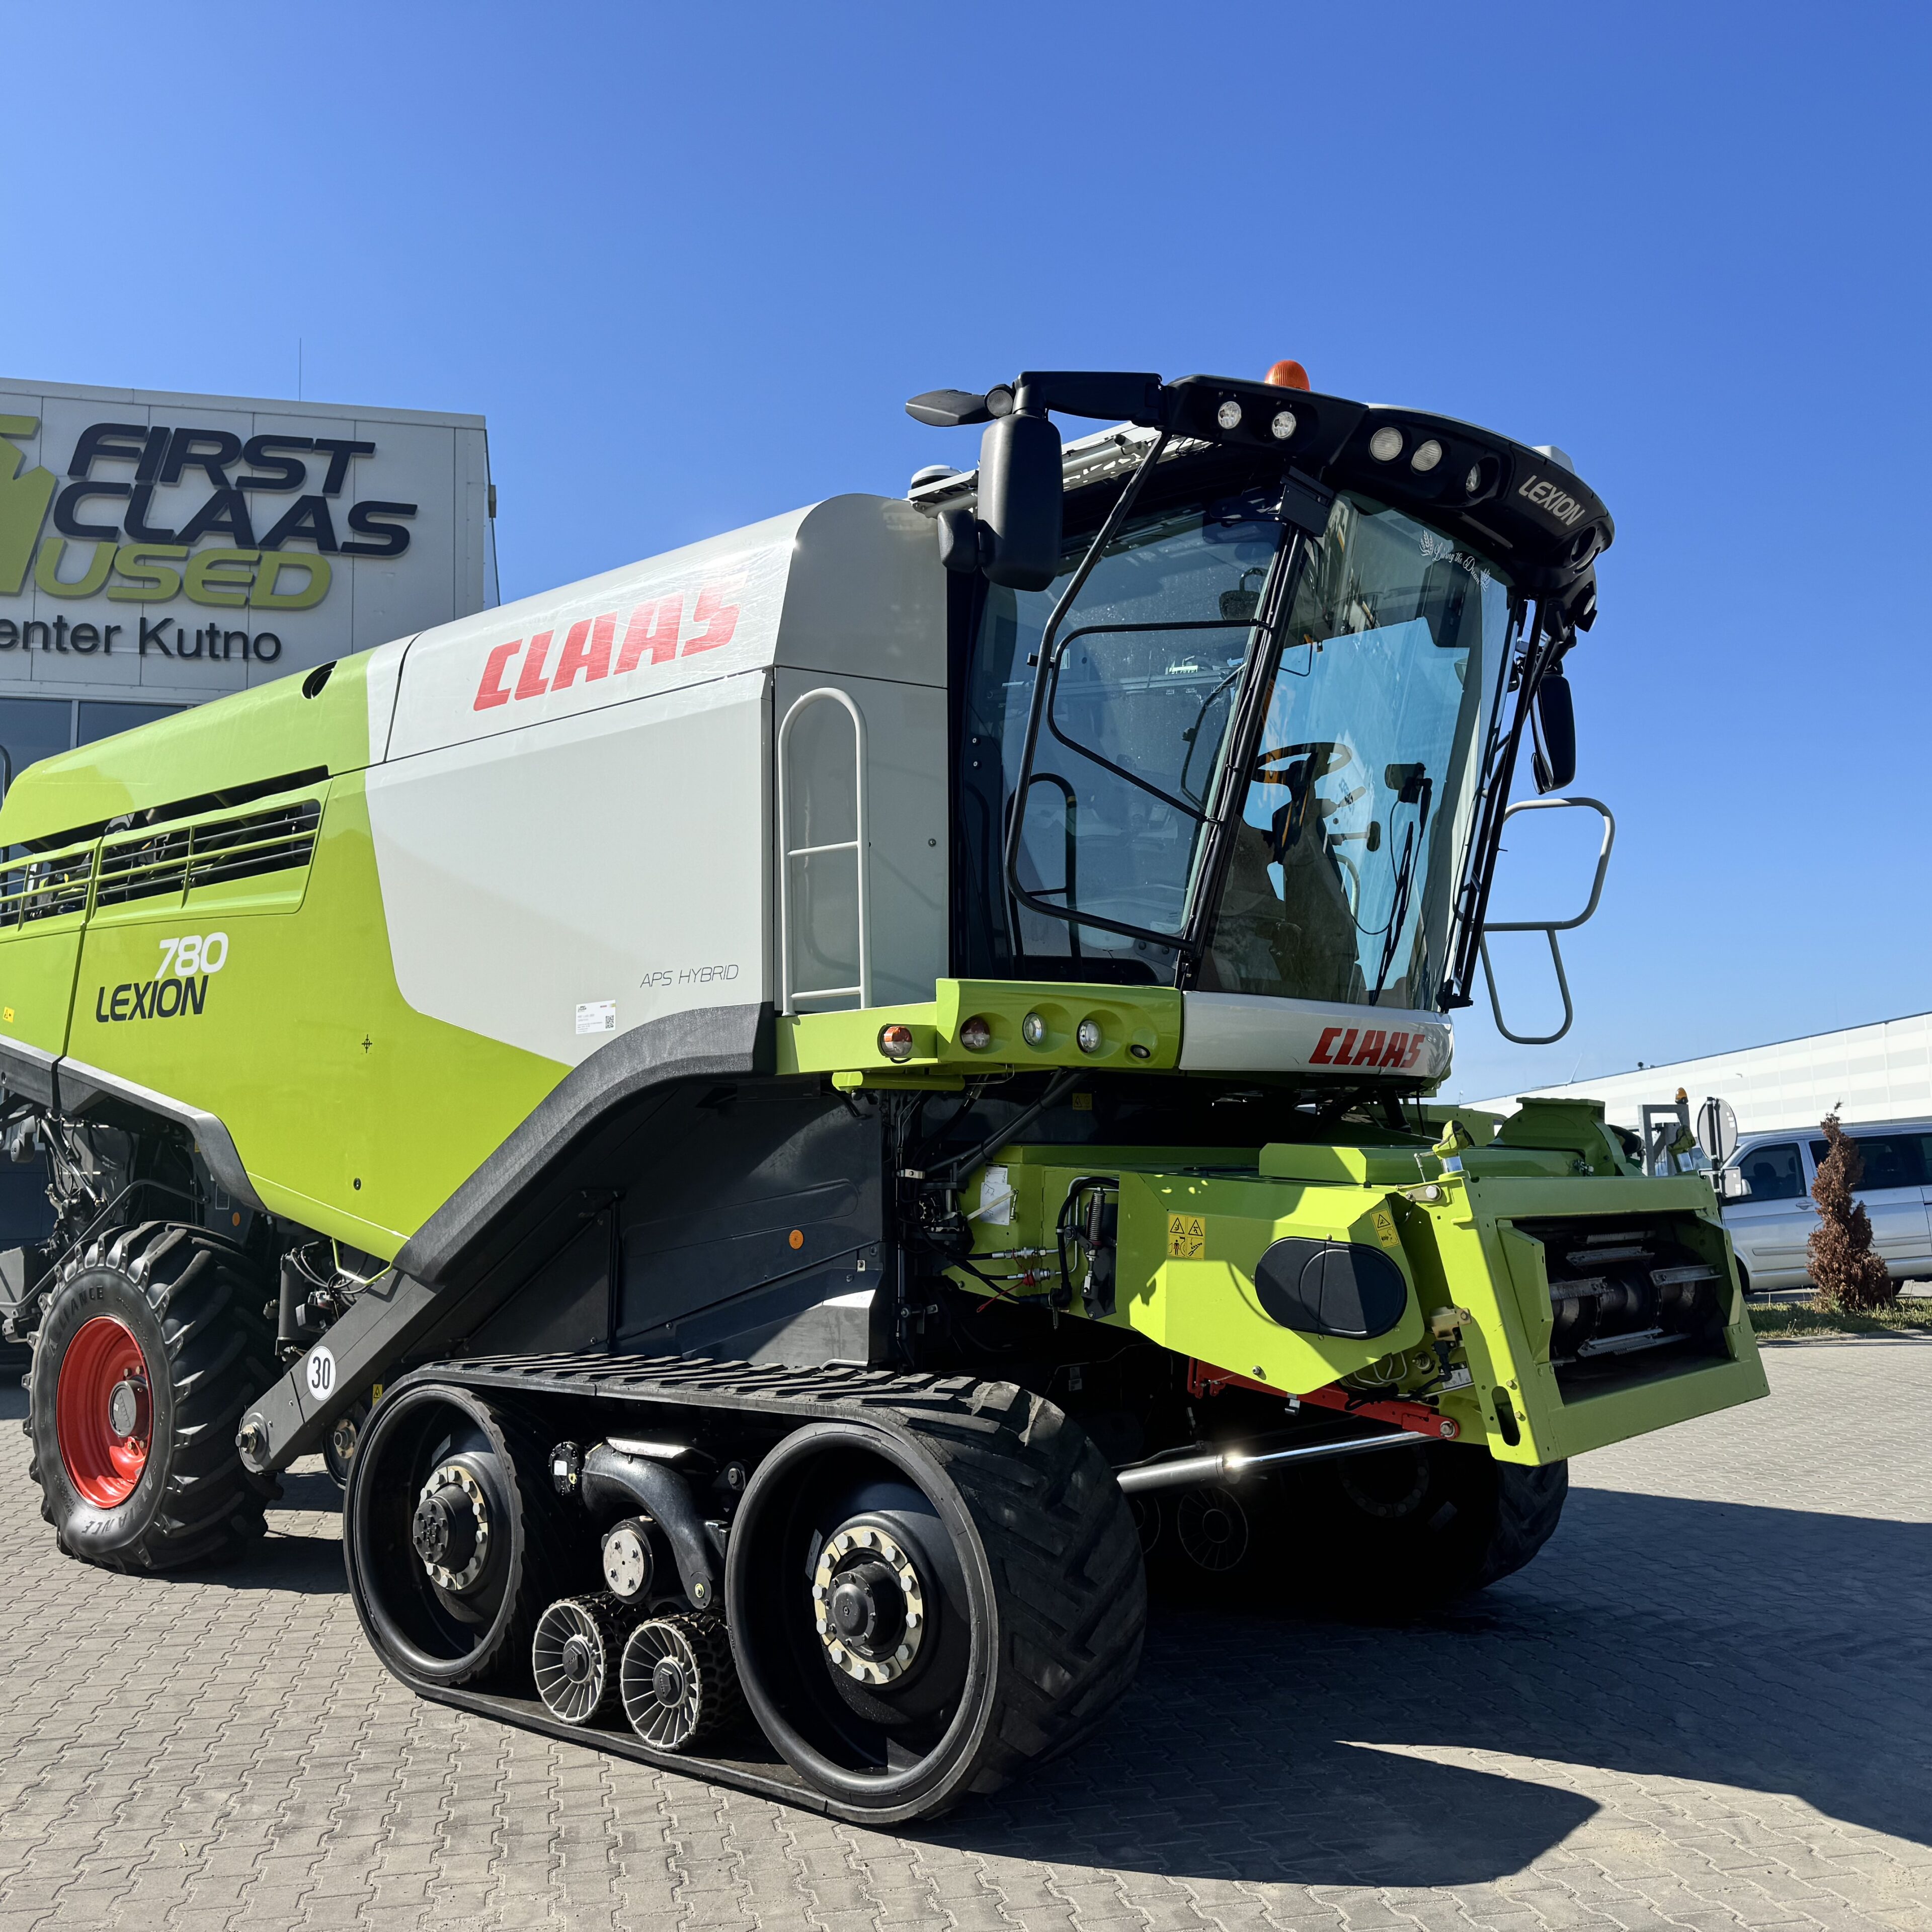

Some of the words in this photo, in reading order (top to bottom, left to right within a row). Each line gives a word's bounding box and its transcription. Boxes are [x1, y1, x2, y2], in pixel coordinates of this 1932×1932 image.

[67, 423, 376, 498] FIRST
[53, 481, 418, 558] CLAAS
[1519, 475, 1584, 526] LEXION
[34, 537, 333, 610] USED
[1432, 542, 1455, 563] Living
[1455, 552, 1463, 565] the
[1463, 556, 1481, 585] Dream
[139, 617, 282, 663] Kutno
[473, 571, 749, 711] CLAAS
[155, 932, 228, 979] 780
[640, 971, 673, 988] APS
[678, 964, 739, 984] HYBRID
[96, 975, 209, 1023] LEXION
[1308, 1027, 1425, 1068] CLAAS
[311, 1356, 331, 1391] 30
